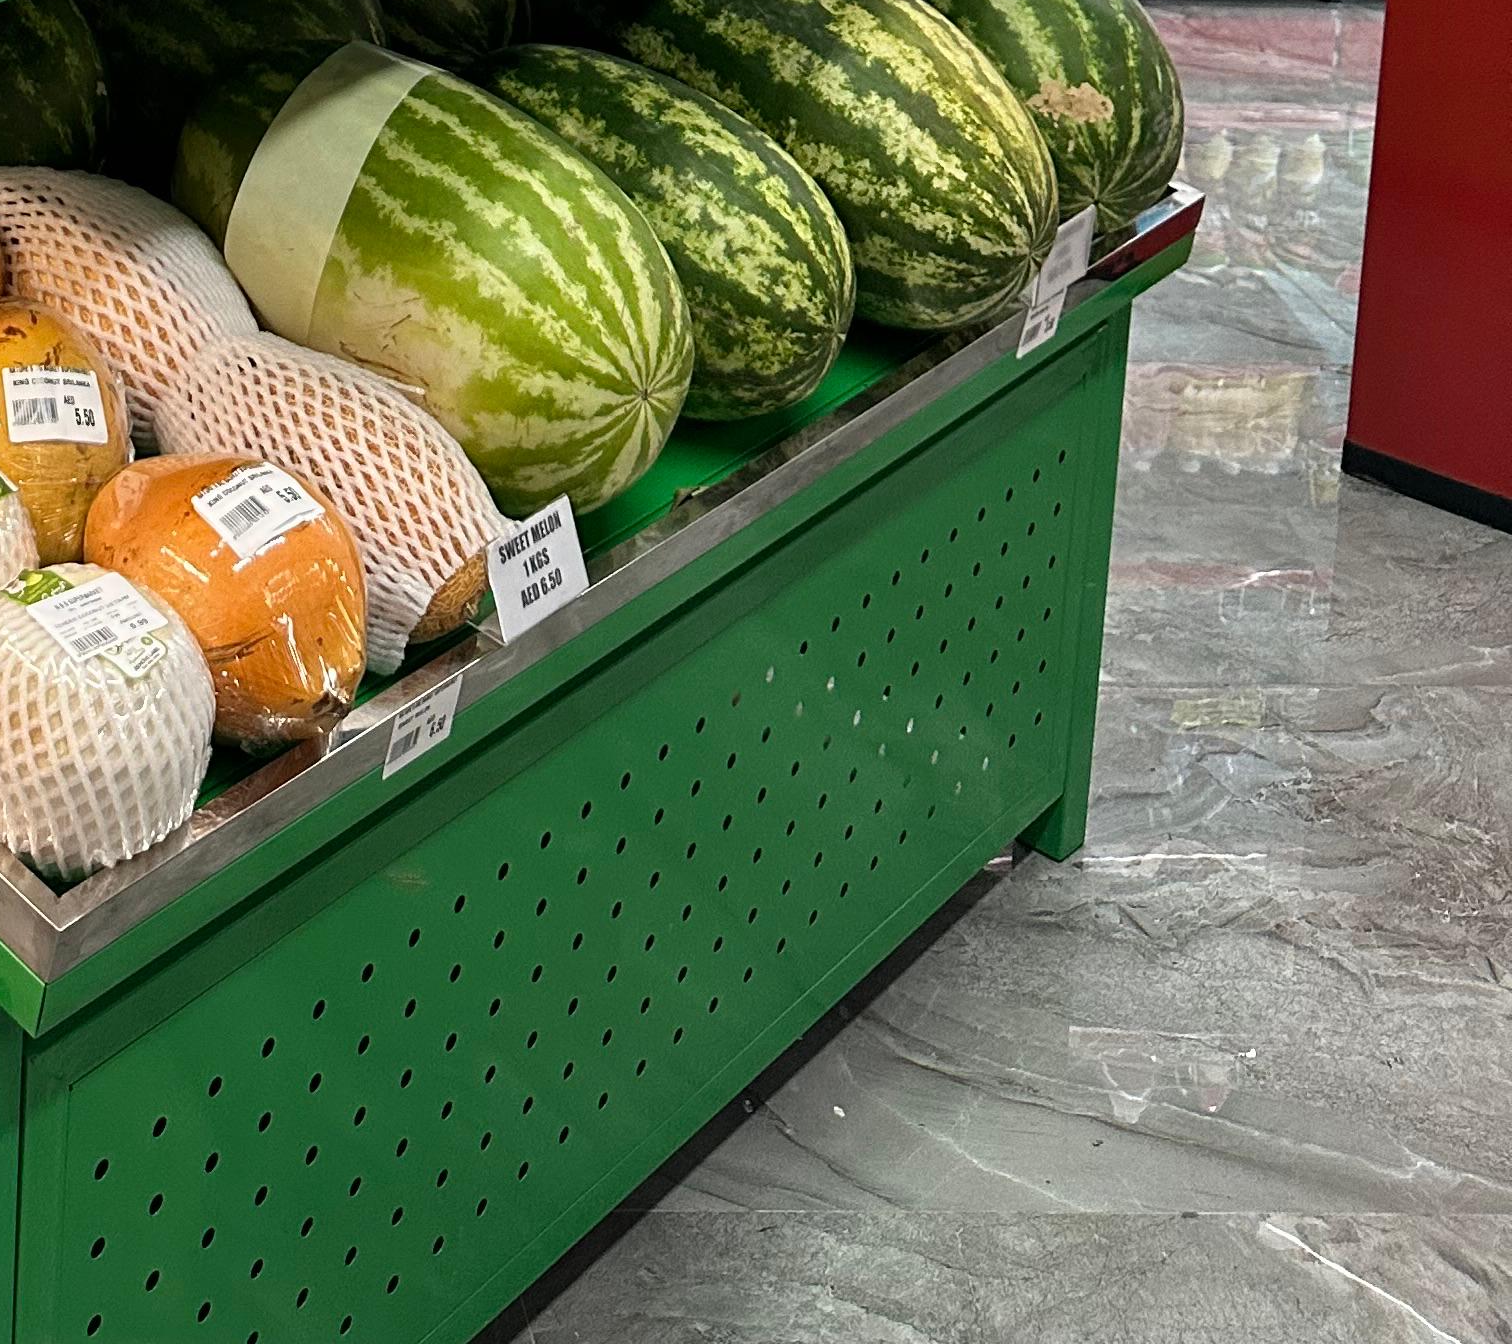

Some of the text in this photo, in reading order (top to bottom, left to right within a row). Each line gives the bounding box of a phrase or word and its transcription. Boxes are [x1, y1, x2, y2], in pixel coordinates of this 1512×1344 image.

[63, 395, 75, 405] AED
[75, 408, 95, 427] 5.50
[498, 511, 563, 564] SWEET MELON
[522, 547, 551, 578] 1 KGS
[520, 567, 563, 609] AED 6.50
